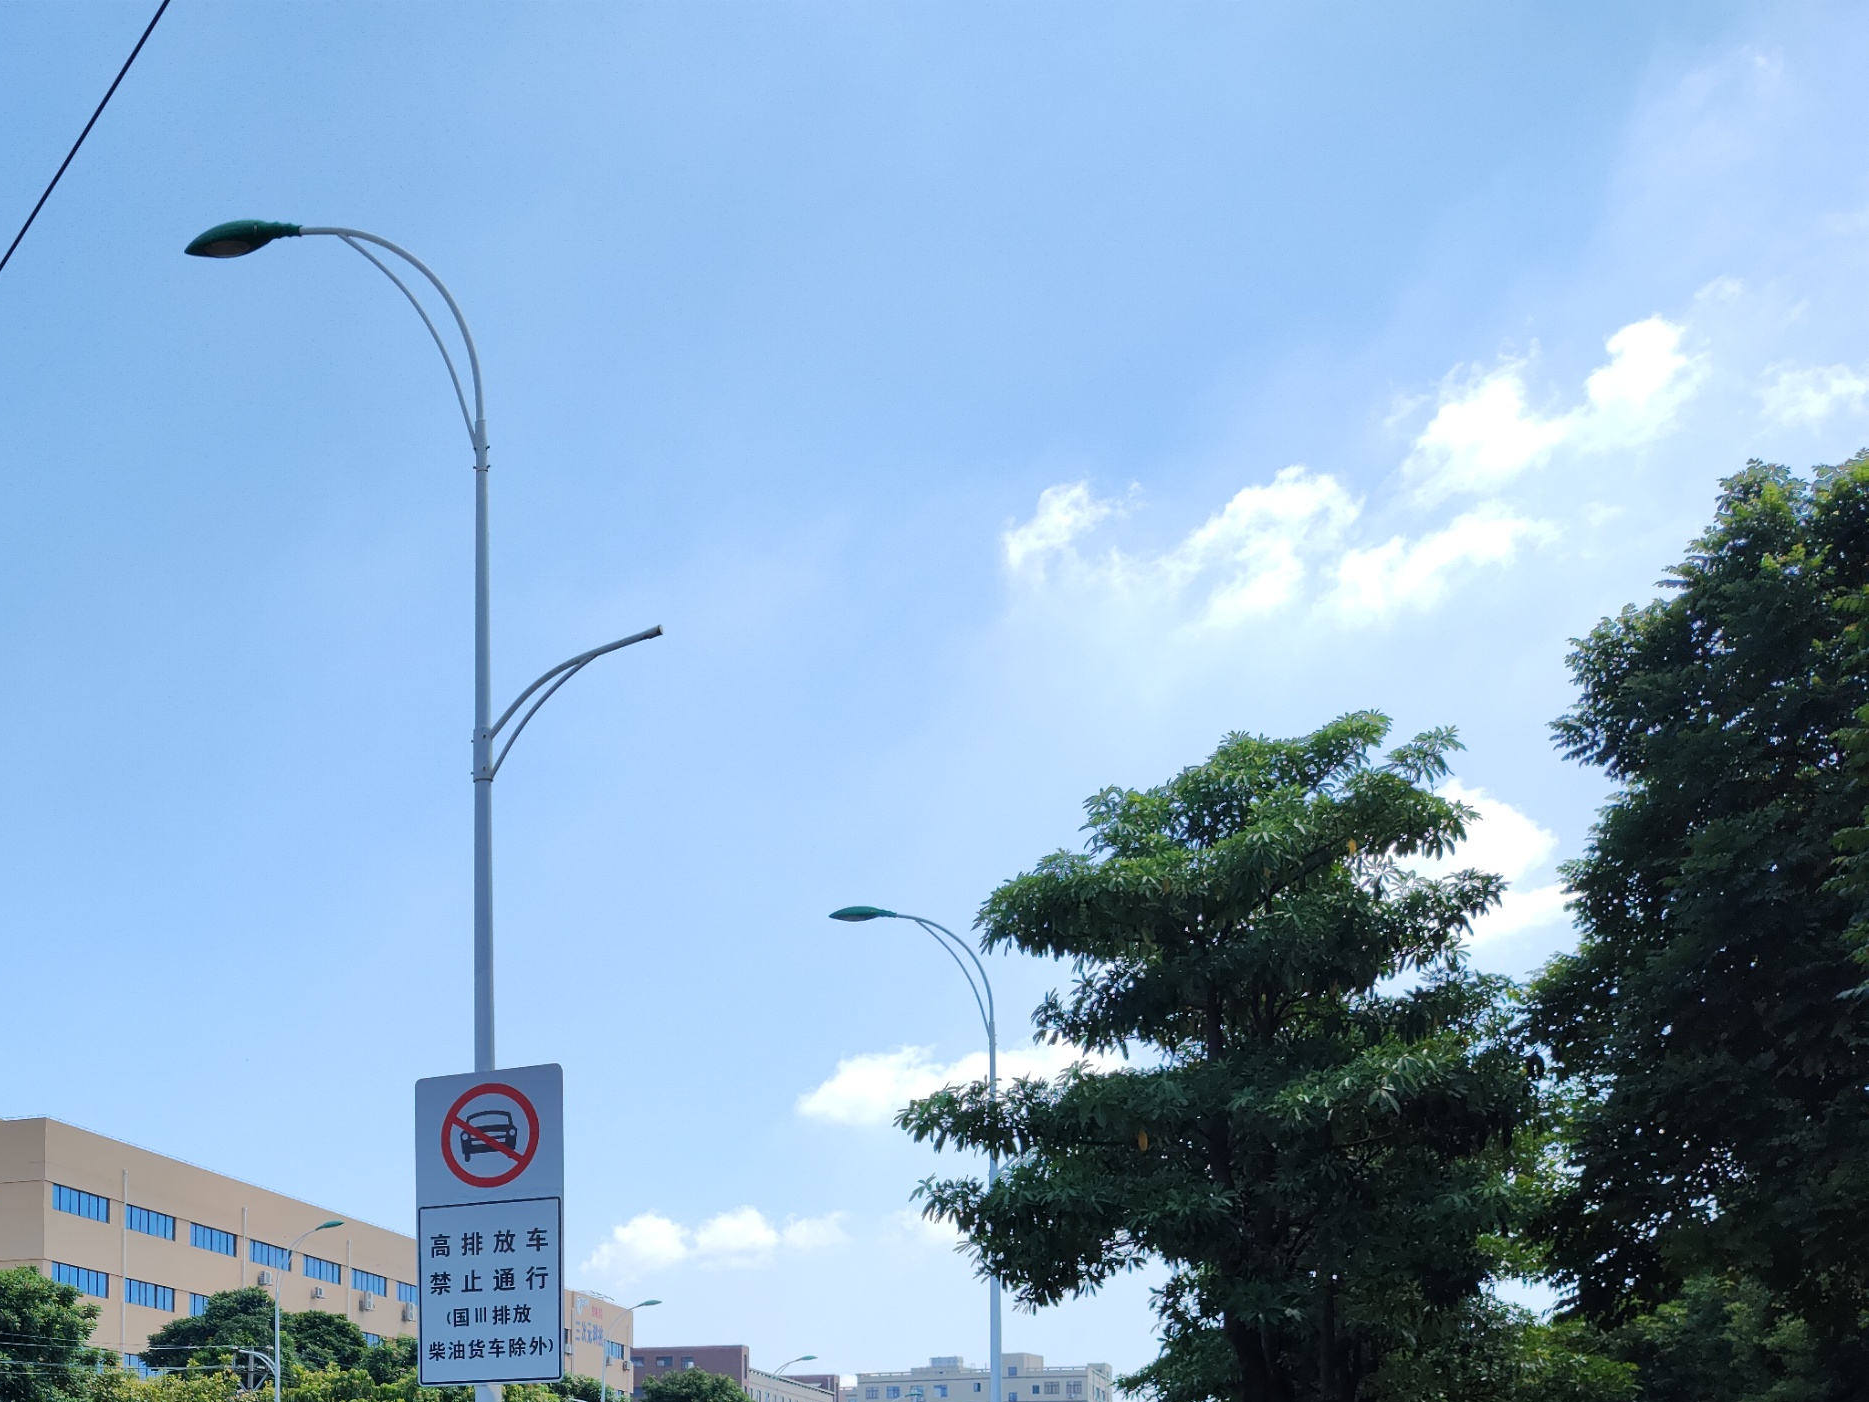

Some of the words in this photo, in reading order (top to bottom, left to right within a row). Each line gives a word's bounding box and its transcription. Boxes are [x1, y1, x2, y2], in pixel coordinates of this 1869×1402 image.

[430, 1227, 549, 1258] 高排放车
[430, 1266, 549, 1295] 禁止通行
[429, 1336, 554, 1361] 柴油货车除外)
